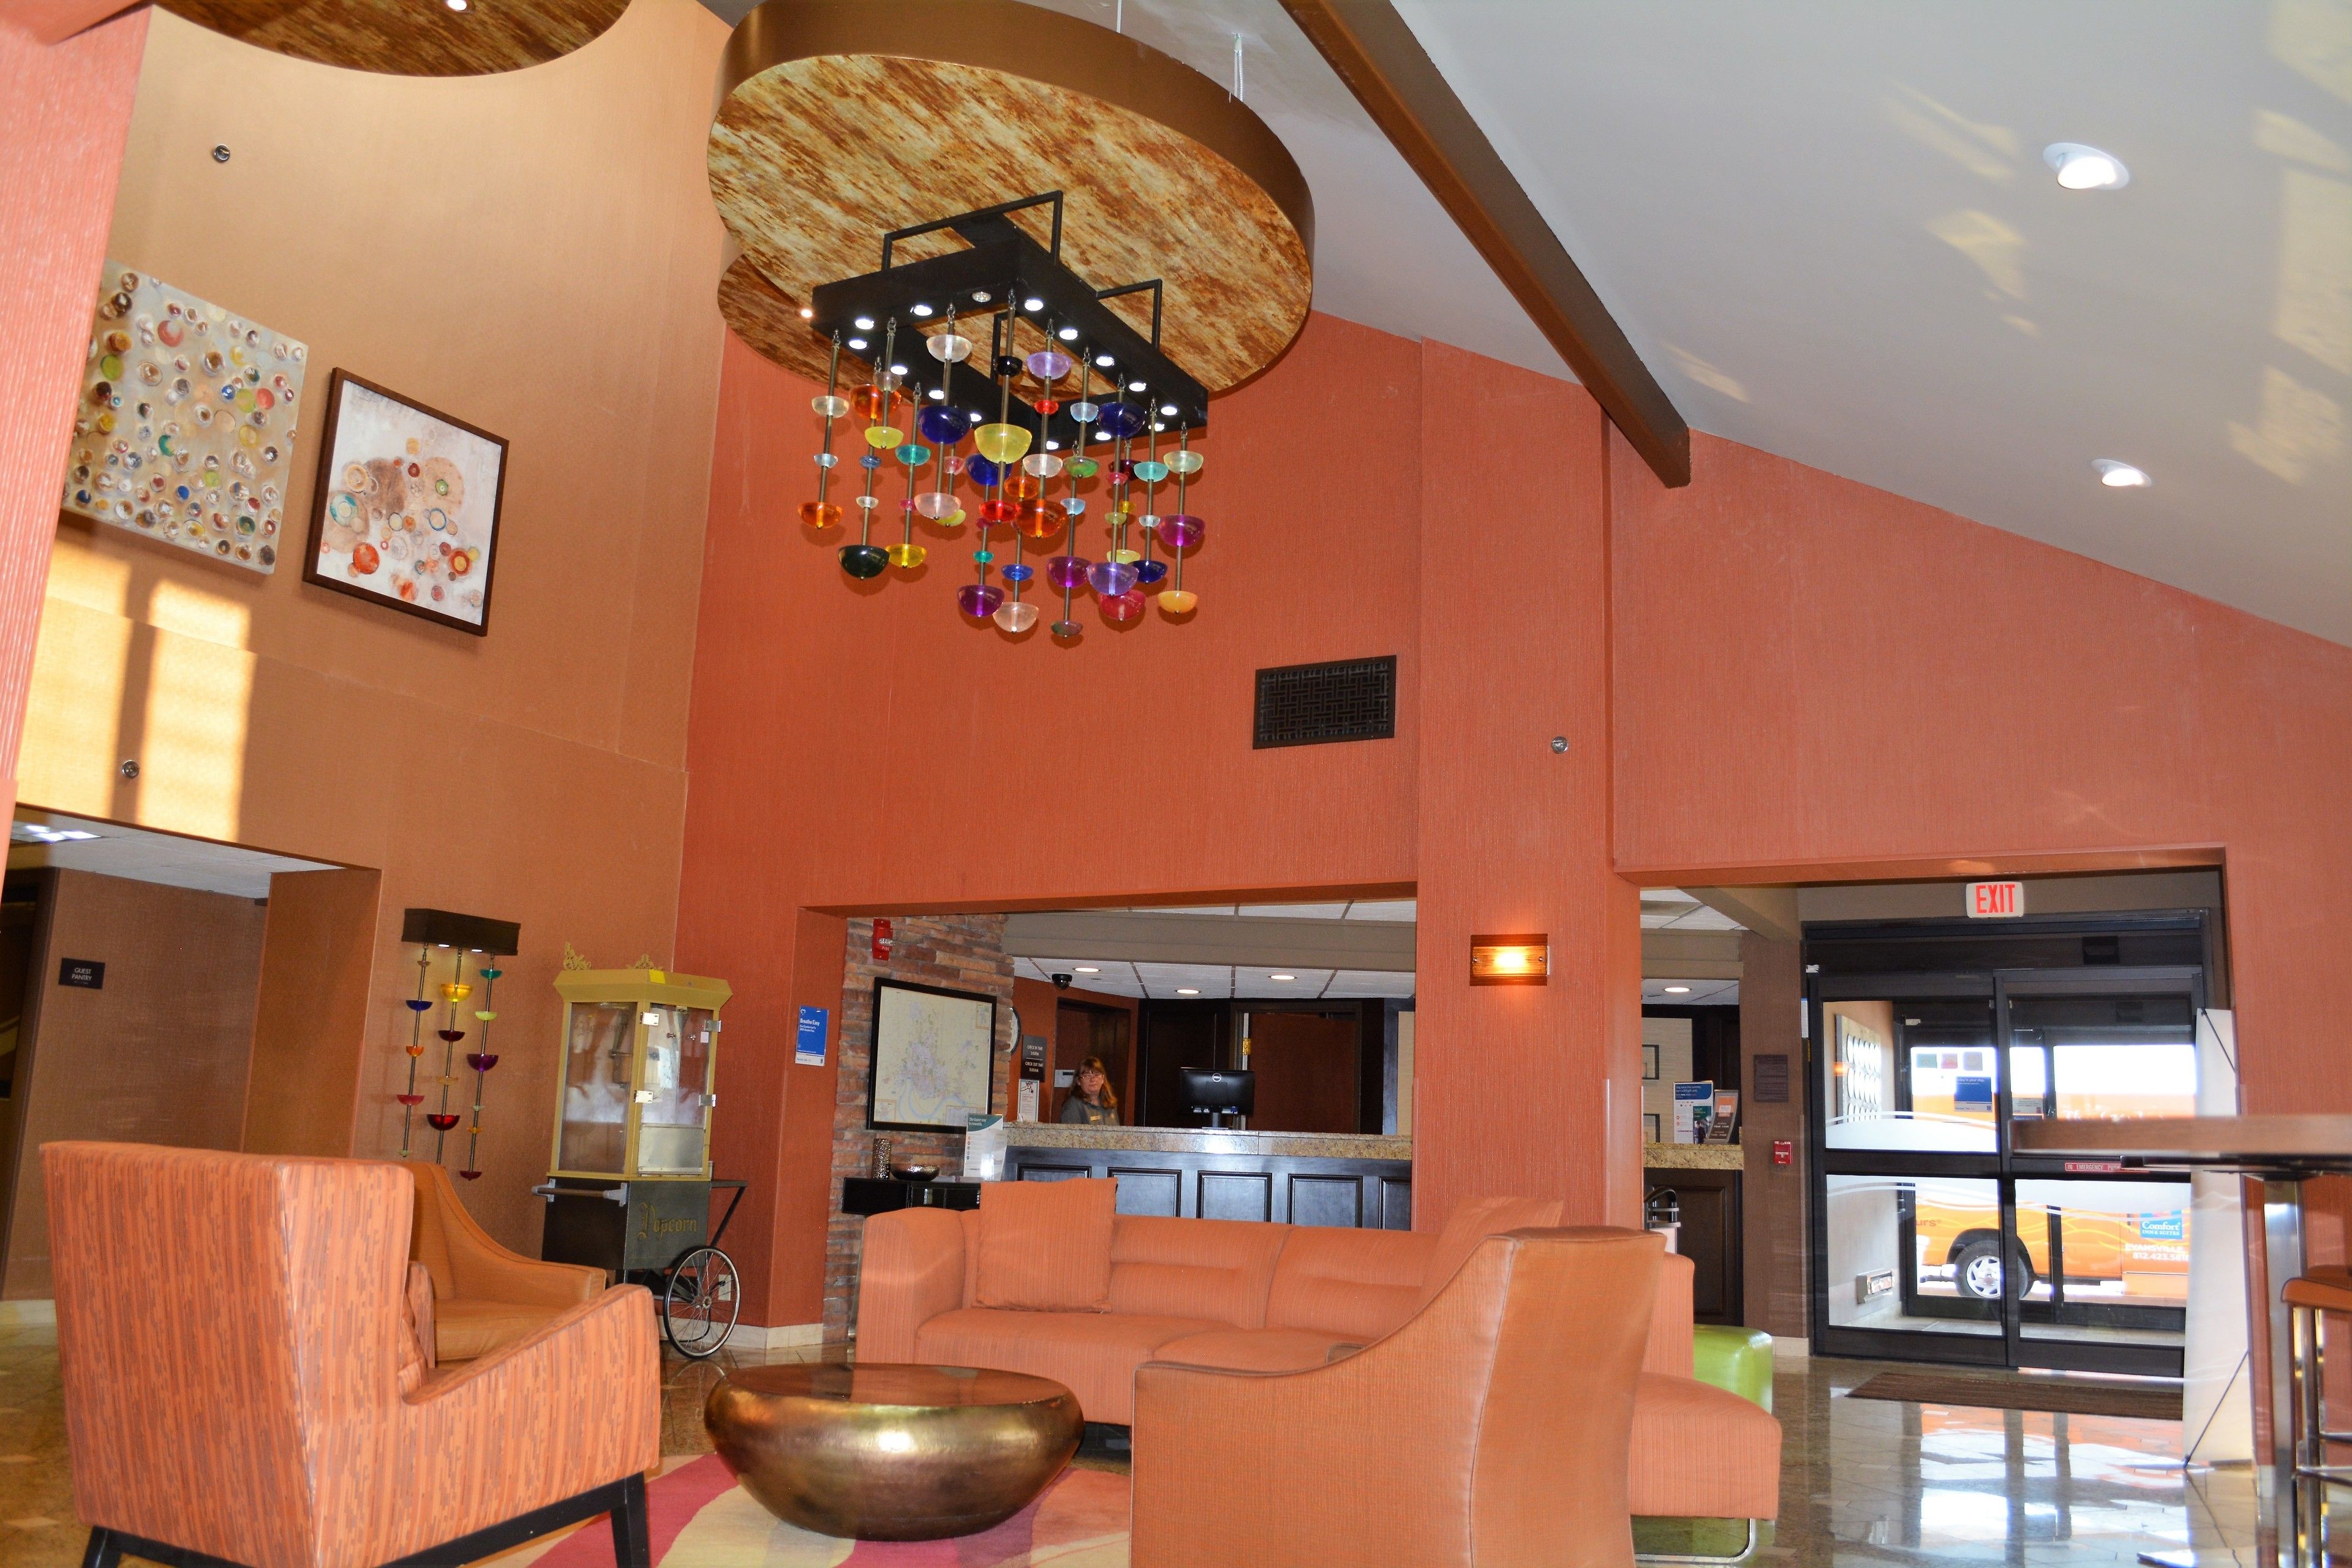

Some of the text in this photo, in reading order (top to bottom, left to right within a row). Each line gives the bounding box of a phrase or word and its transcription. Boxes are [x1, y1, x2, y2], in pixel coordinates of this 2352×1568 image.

[1975, 884, 2016, 913] EXIT
[638, 1202, 696, 1241] Popcorn
[2141, 1221, 2180, 1231] Comfort
